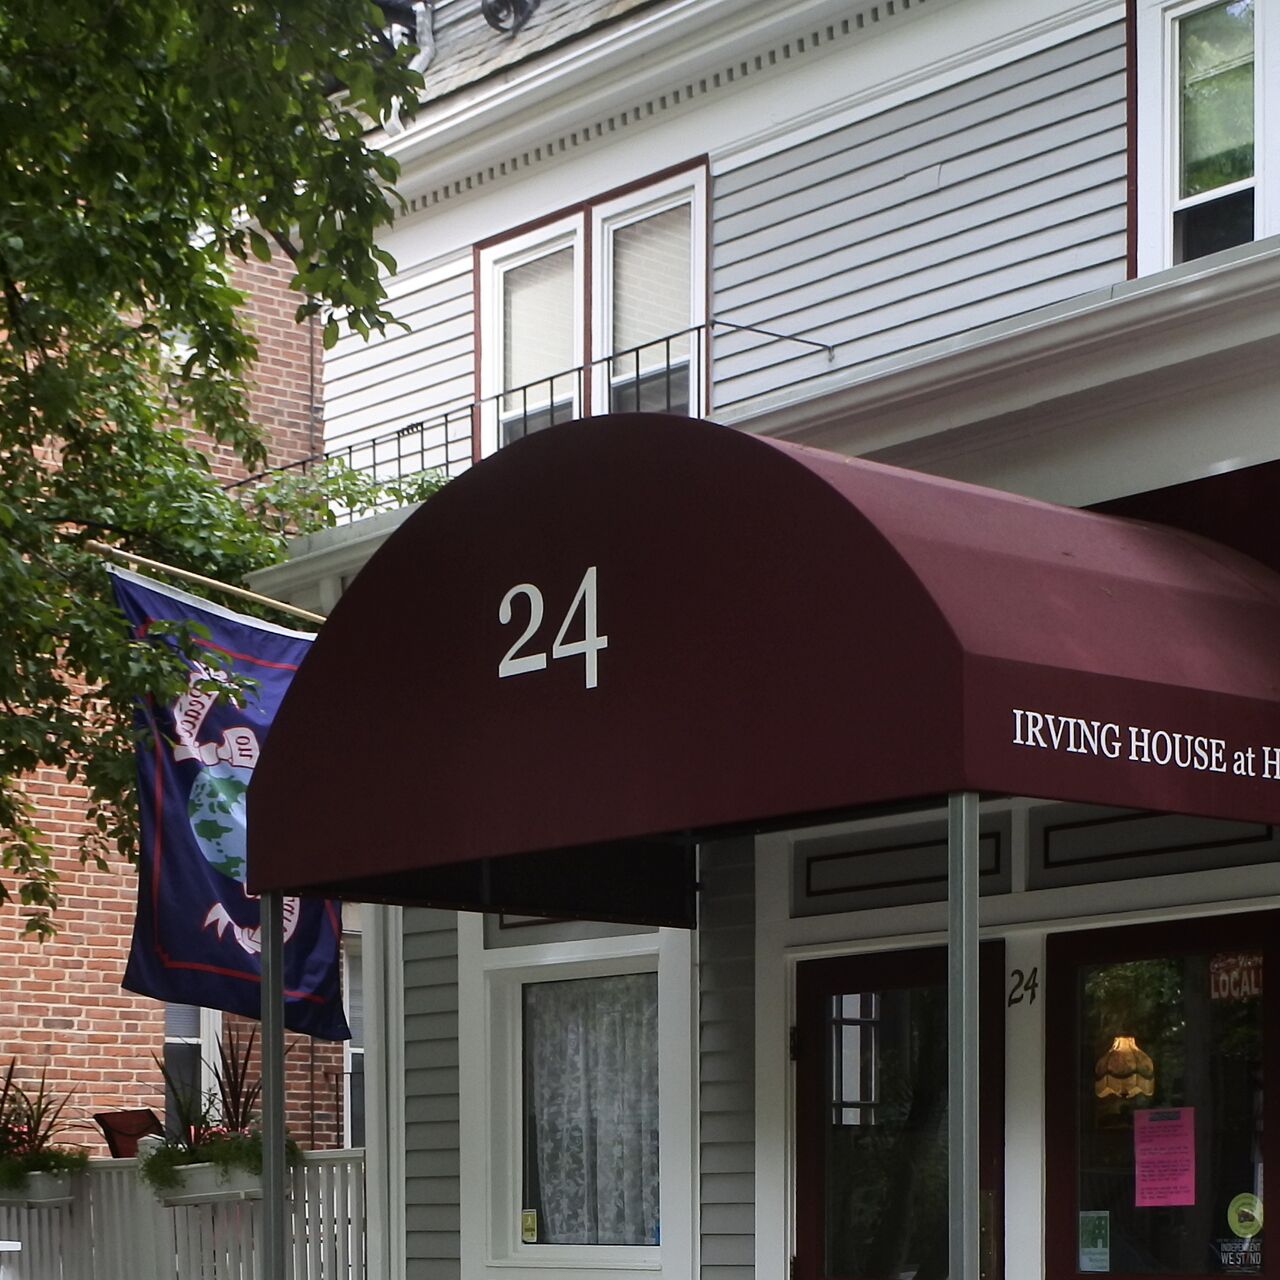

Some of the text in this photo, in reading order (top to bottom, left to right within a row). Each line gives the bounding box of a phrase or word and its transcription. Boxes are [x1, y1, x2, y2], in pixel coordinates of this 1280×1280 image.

[498, 566, 608, 689] 24
[1012, 709, 1122, 758] IRVING
[1128, 727, 1227, 773] HOUSE
[1233, 747, 1256, 777] at
[1008, 967, 1039, 1007] 24
